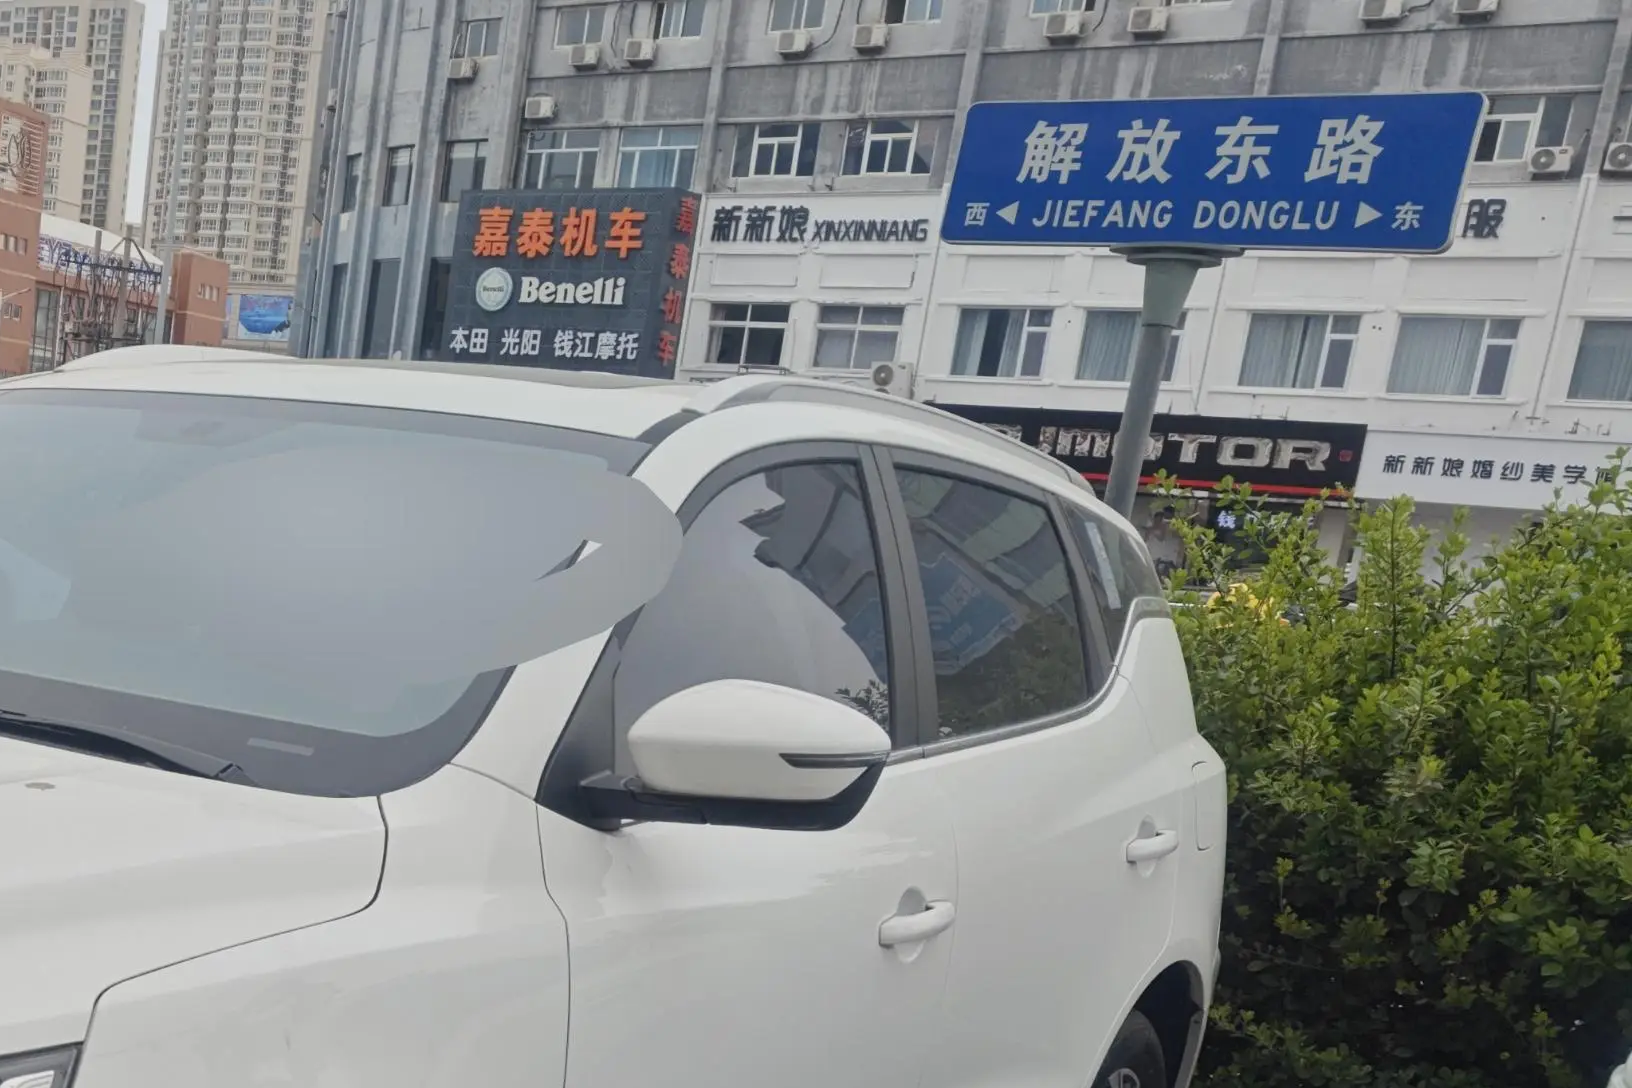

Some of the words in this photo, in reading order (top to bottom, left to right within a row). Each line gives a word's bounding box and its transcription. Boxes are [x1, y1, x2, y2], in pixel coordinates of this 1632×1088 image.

[1015, 113, 1386, 185] 解放东路
[711, 205, 810, 242] 新新娘
[811, 218, 930, 243] XINXINNIANG
[964, 202, 990, 227] 西
[1031, 199, 1174, 229] JIEFANG
[1192, 200, 1340, 230] DONGLU
[1391, 203, 1424, 231] 东
[1462, 198, 1507, 239] 服
[472, 206, 648, 260] 嘉泰机车
[519, 276, 627, 306] Benelli
[657, 196, 697, 367] 嘉泰机车
[449, 327, 489, 354] 本田
[500, 327, 542, 356] 光阳
[553, 329, 640, 361] 钱江摩托
